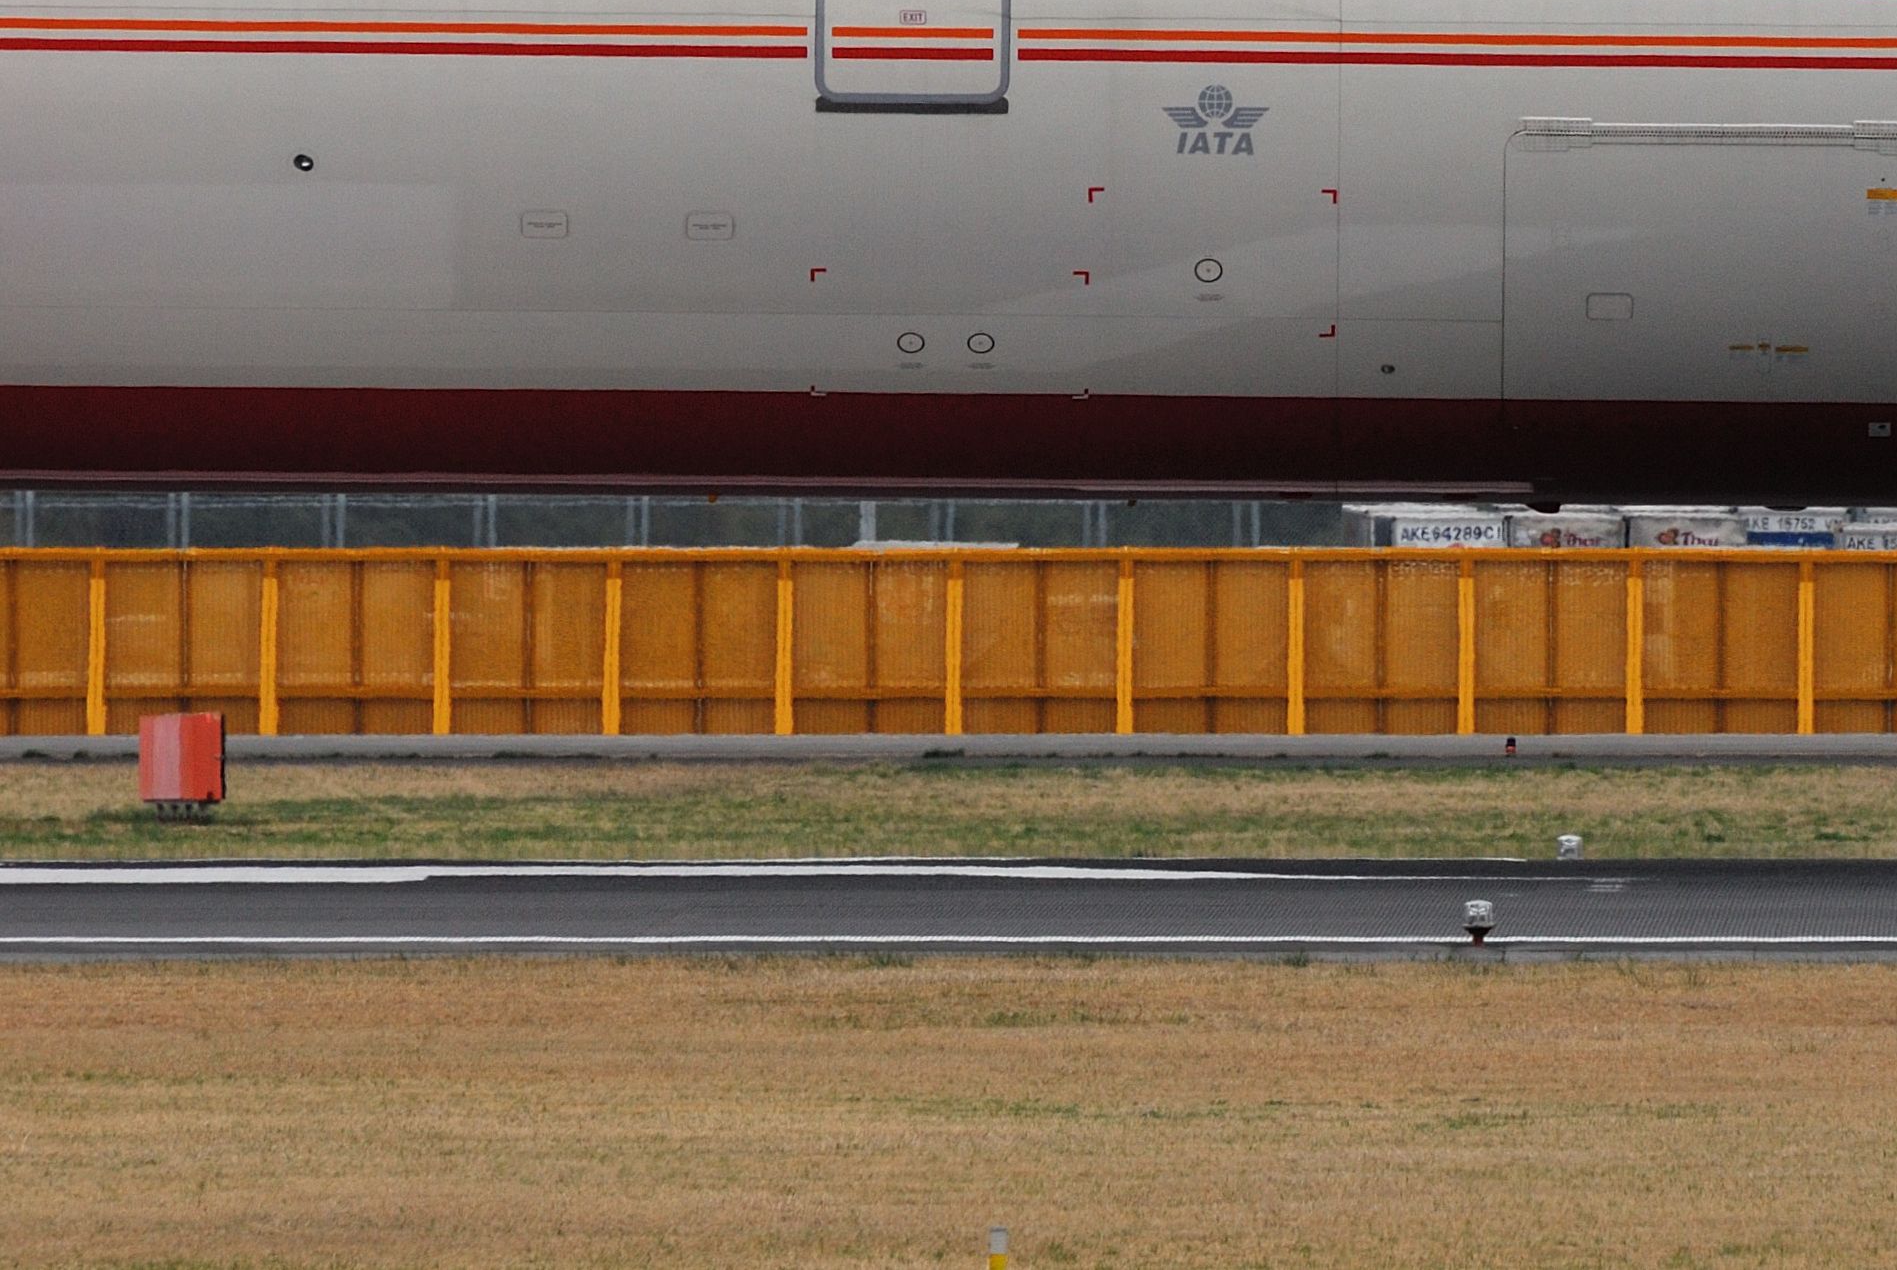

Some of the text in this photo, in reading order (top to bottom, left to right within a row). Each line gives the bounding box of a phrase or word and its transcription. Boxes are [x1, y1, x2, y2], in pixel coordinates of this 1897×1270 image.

[903, 12, 923, 23] EXIT
[1176, 131, 1256, 157] IATA
[1681, 531, 1720, 547] Thai
[1847, 537, 1875, 550] AKE
